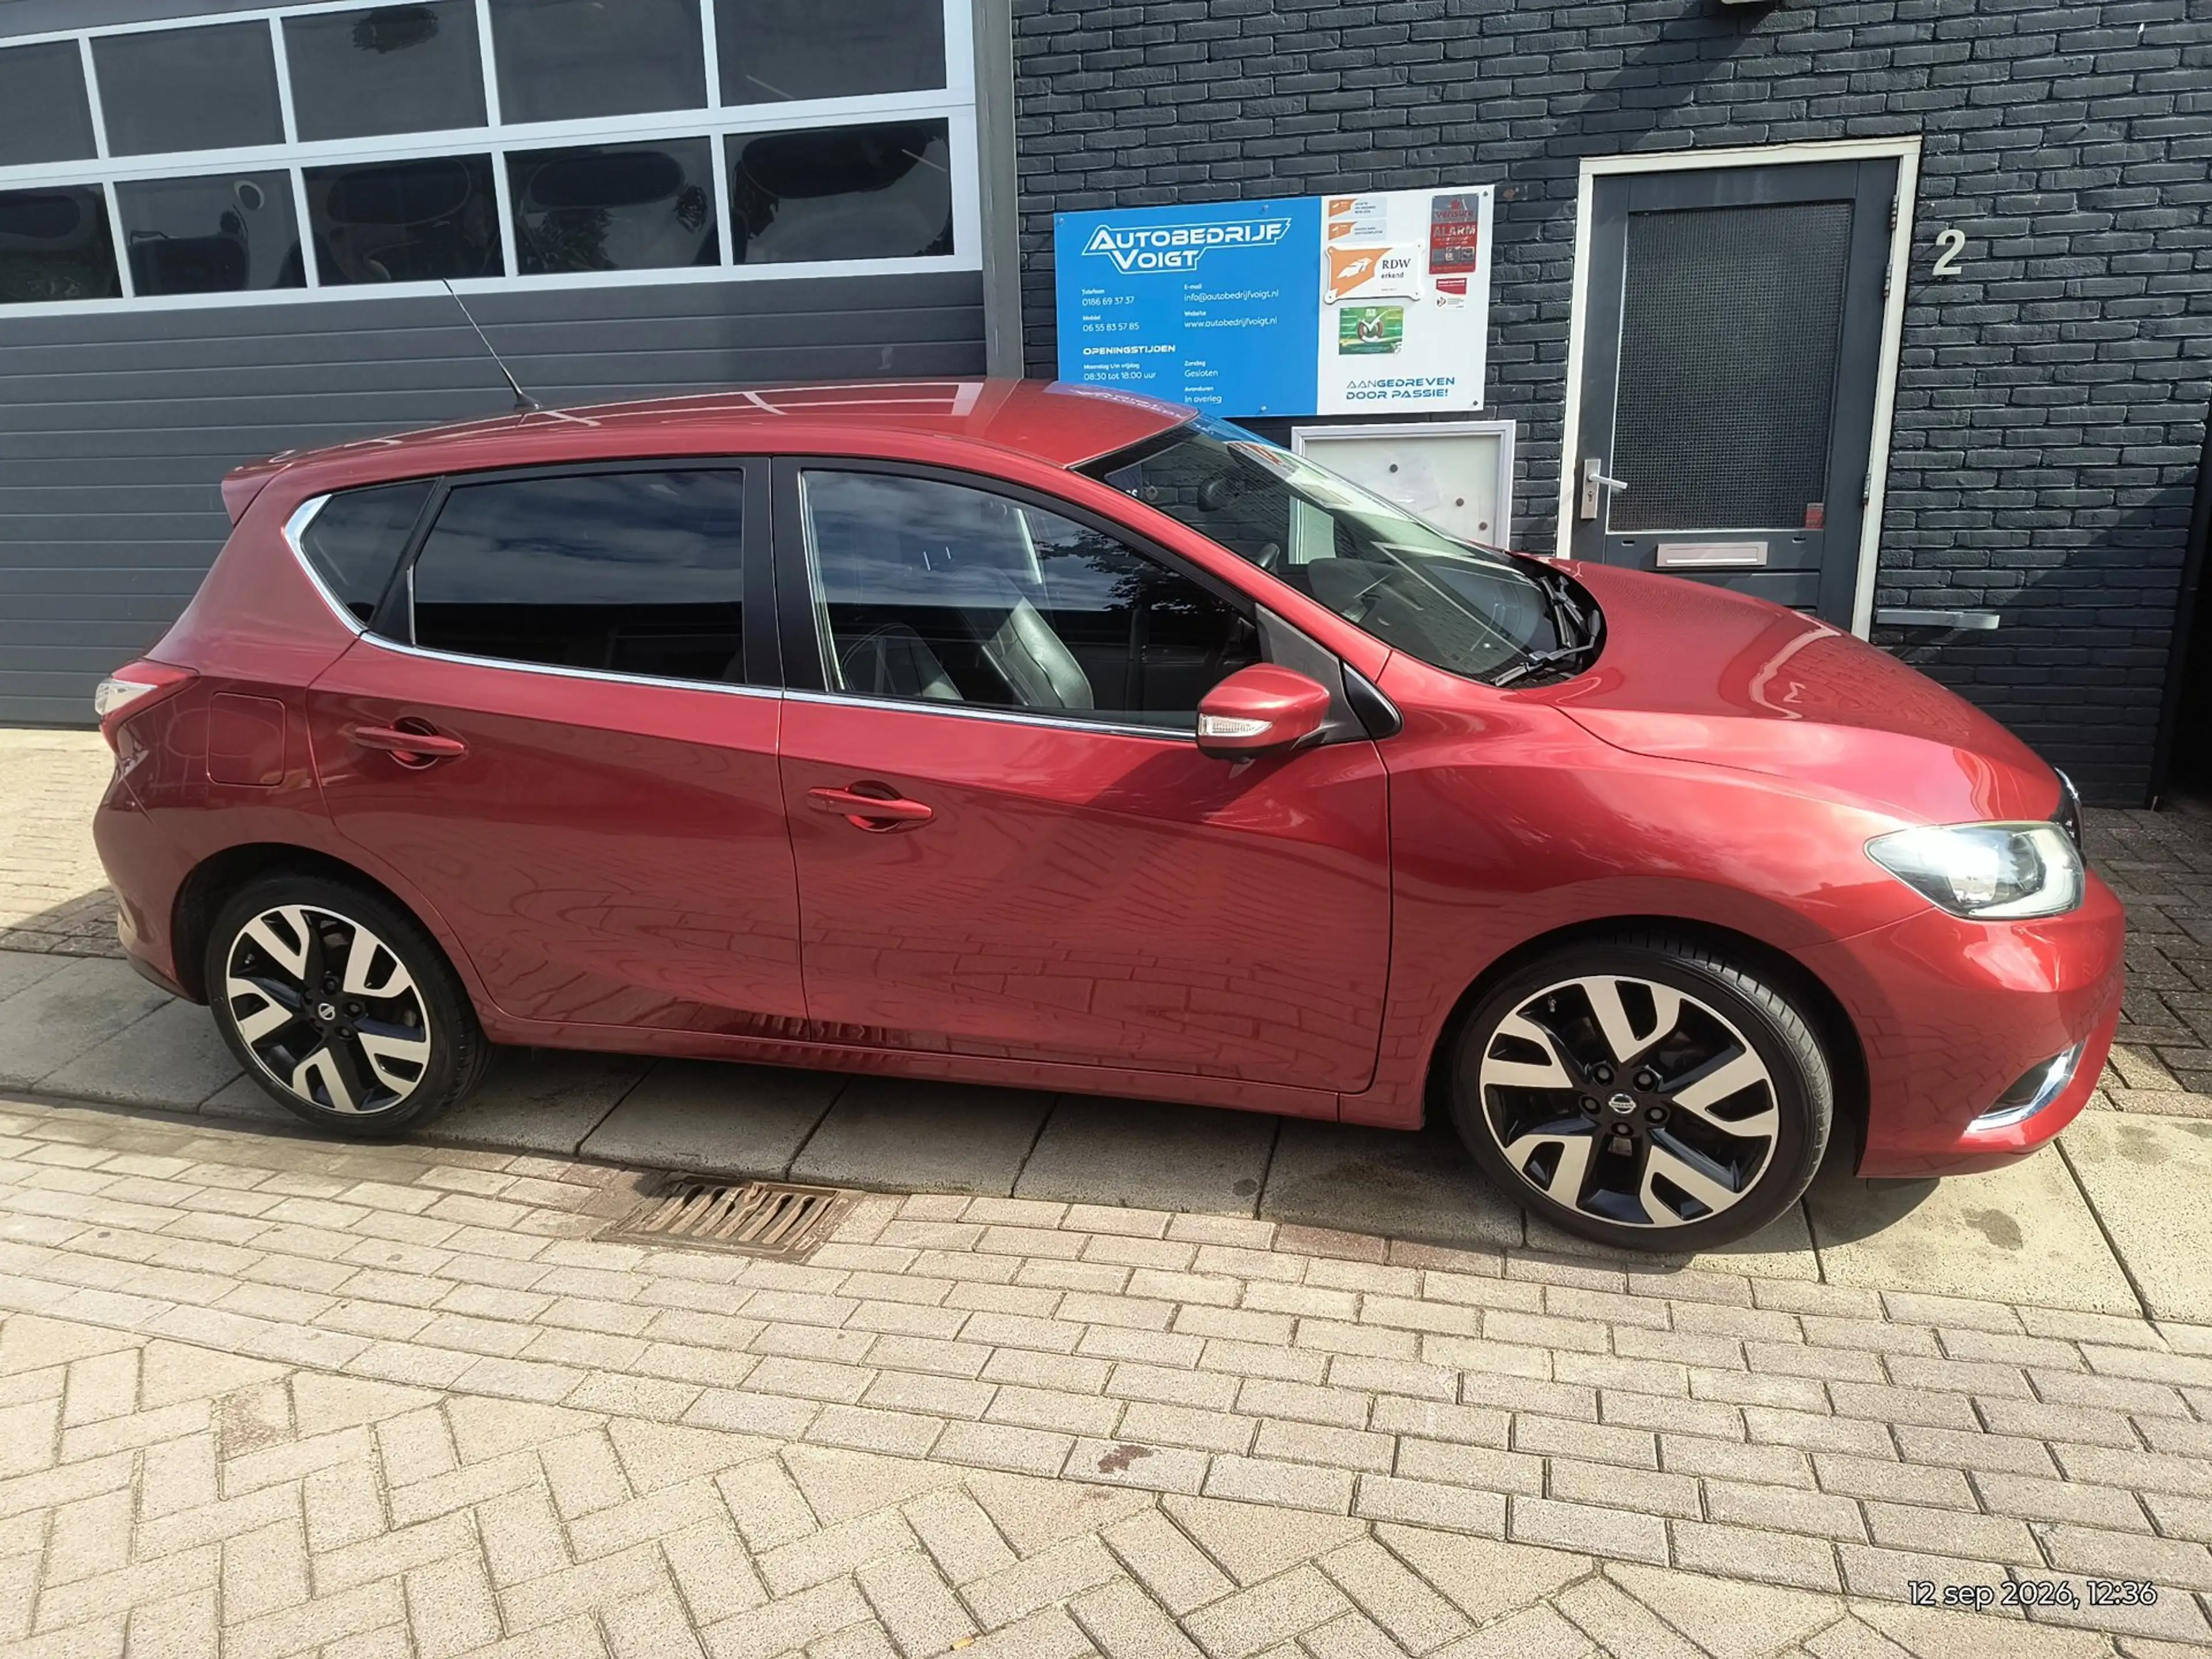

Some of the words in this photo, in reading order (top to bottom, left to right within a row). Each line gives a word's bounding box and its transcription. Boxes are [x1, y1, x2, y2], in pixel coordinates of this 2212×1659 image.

[1433, 224, 1476, 237] ALARM
[1090, 223, 1282, 250] AUTOBEDRIJF
[1932, 229, 1965, 275] 2
[1112, 249, 1199, 270] VOIGT
[1382, 258, 1411, 270] RDW
[1082, 298, 1101, 306] 0186
[1102, 297, 1113, 305] 69
[1114, 297, 1124, 305] 37
[1124, 296, 1135, 304] 37
[1184, 289, 1279, 302] info@autobedrijfvoigt.nl
[1082, 324, 1094, 332] 06
[1095, 323, 1105, 332] 55
[1106, 323, 1116, 331] 83
[1118, 323, 1127, 331] 57
[1128, 322, 1139, 330] 85
[1184, 316, 1277, 327] www.autobedrijfvoigt.nl
[1083, 345, 1176, 355] OPENINGSTIJDEN
[1084, 373, 1107, 381] 08:30
[1184, 369, 1218, 377] Gesloten
[1346, 377, 1455, 389] AANGEDREVEN
[1193, 395, 1222, 404] overleg
[1346, 391, 1387, 400] DOOR
[1391, 389, 1448, 398] PASSIE!
